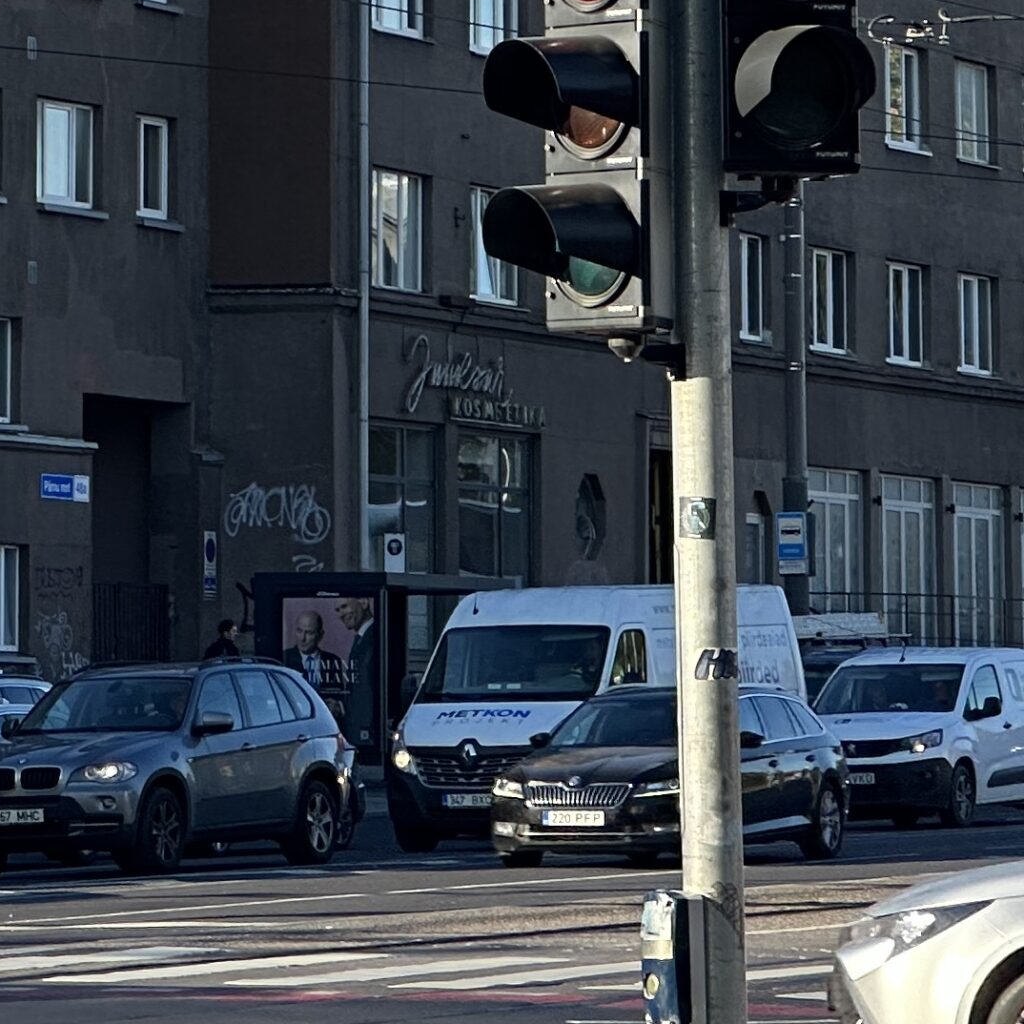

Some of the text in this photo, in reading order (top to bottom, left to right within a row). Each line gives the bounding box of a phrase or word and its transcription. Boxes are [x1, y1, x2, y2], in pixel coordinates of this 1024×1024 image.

[436, 709, 531, 720] METKON
[16, 810, 40, 821] MHC
[552, 813, 601, 824] 220 PFP
